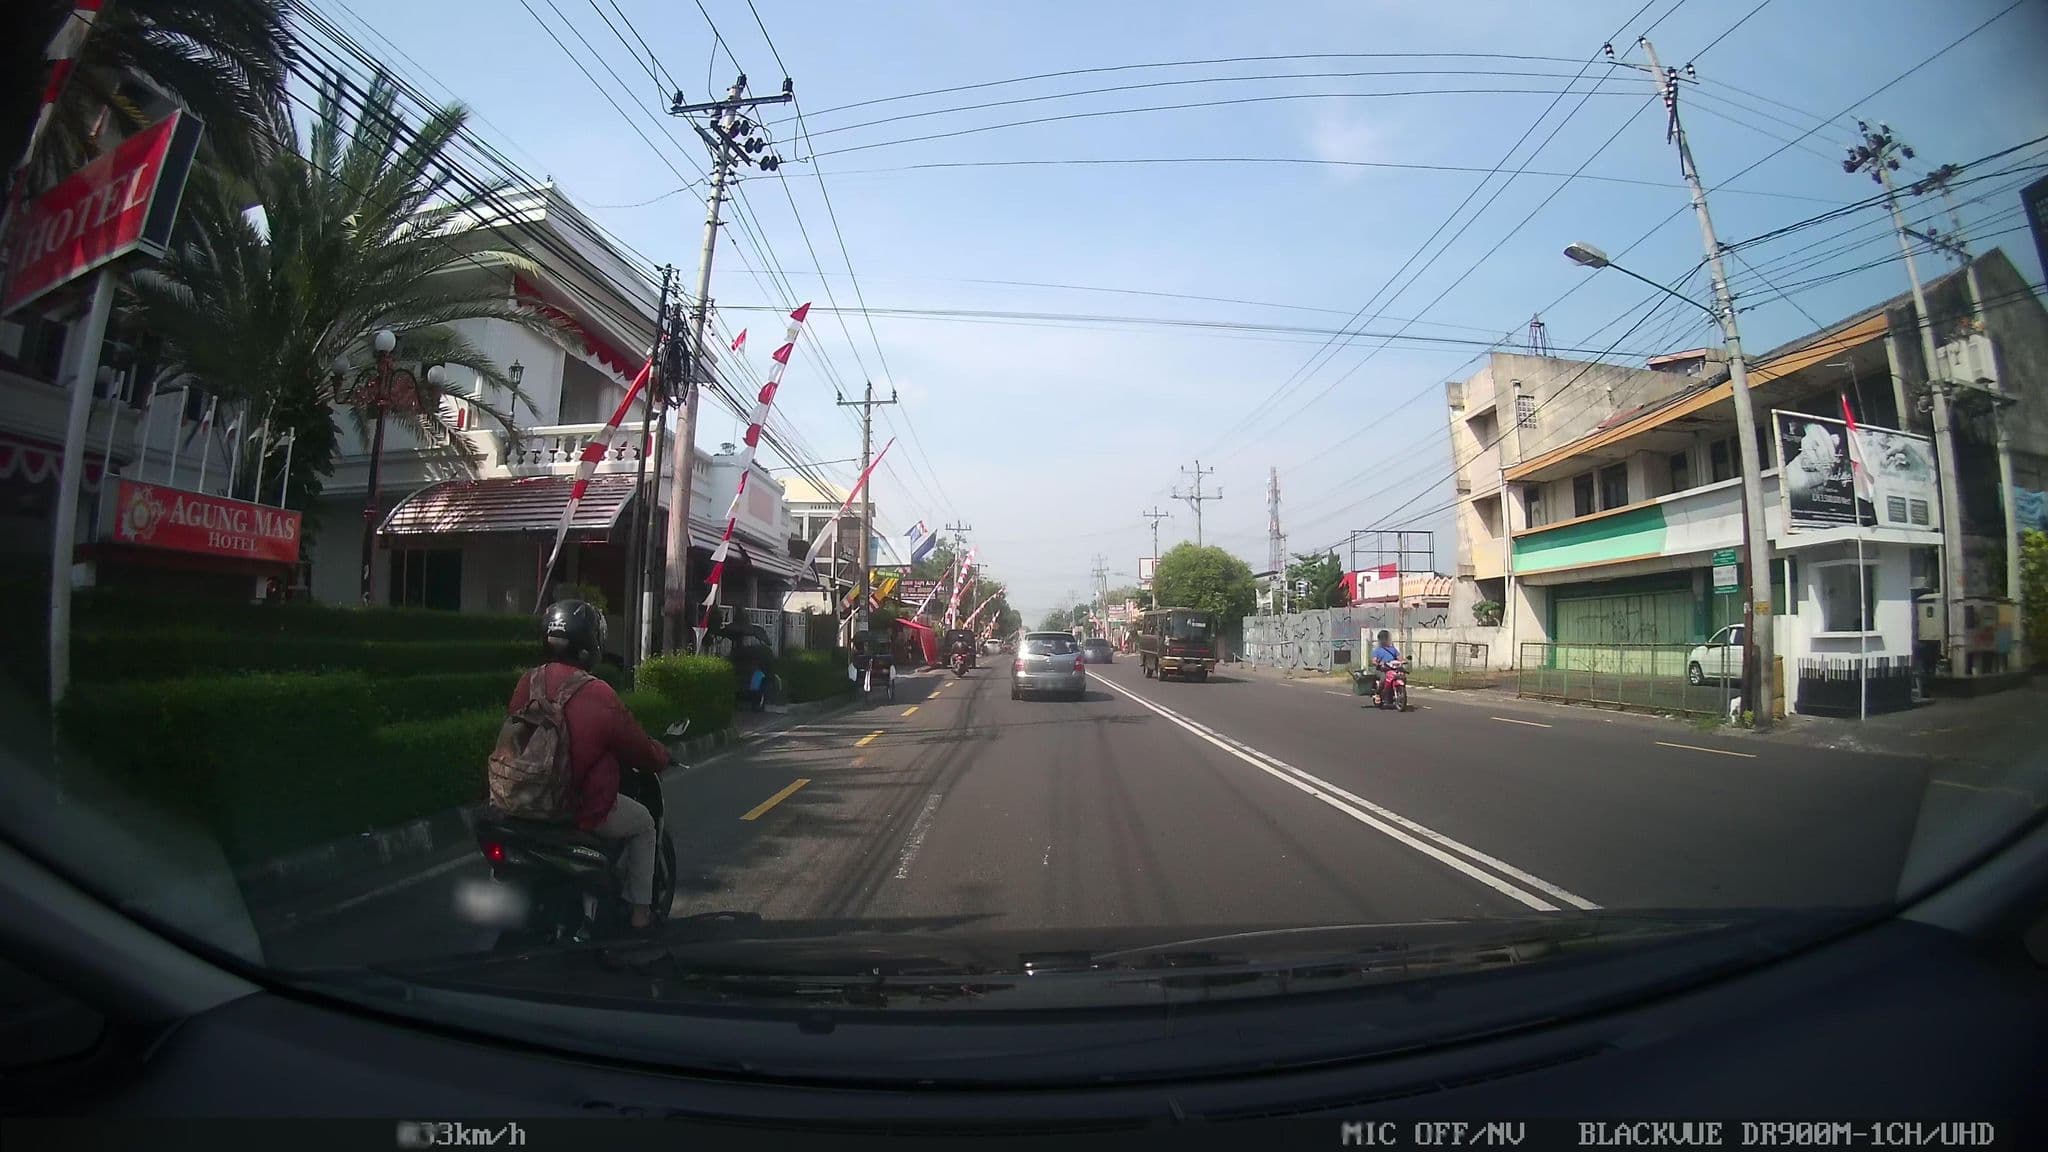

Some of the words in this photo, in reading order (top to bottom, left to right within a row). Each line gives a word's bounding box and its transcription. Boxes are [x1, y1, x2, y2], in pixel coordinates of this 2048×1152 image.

[20, 163, 150, 270] HOTEL
[169, 496, 248, 533] AGUNG
[253, 509, 296, 540] MAS
[207, 531, 257, 551] HOTEL
